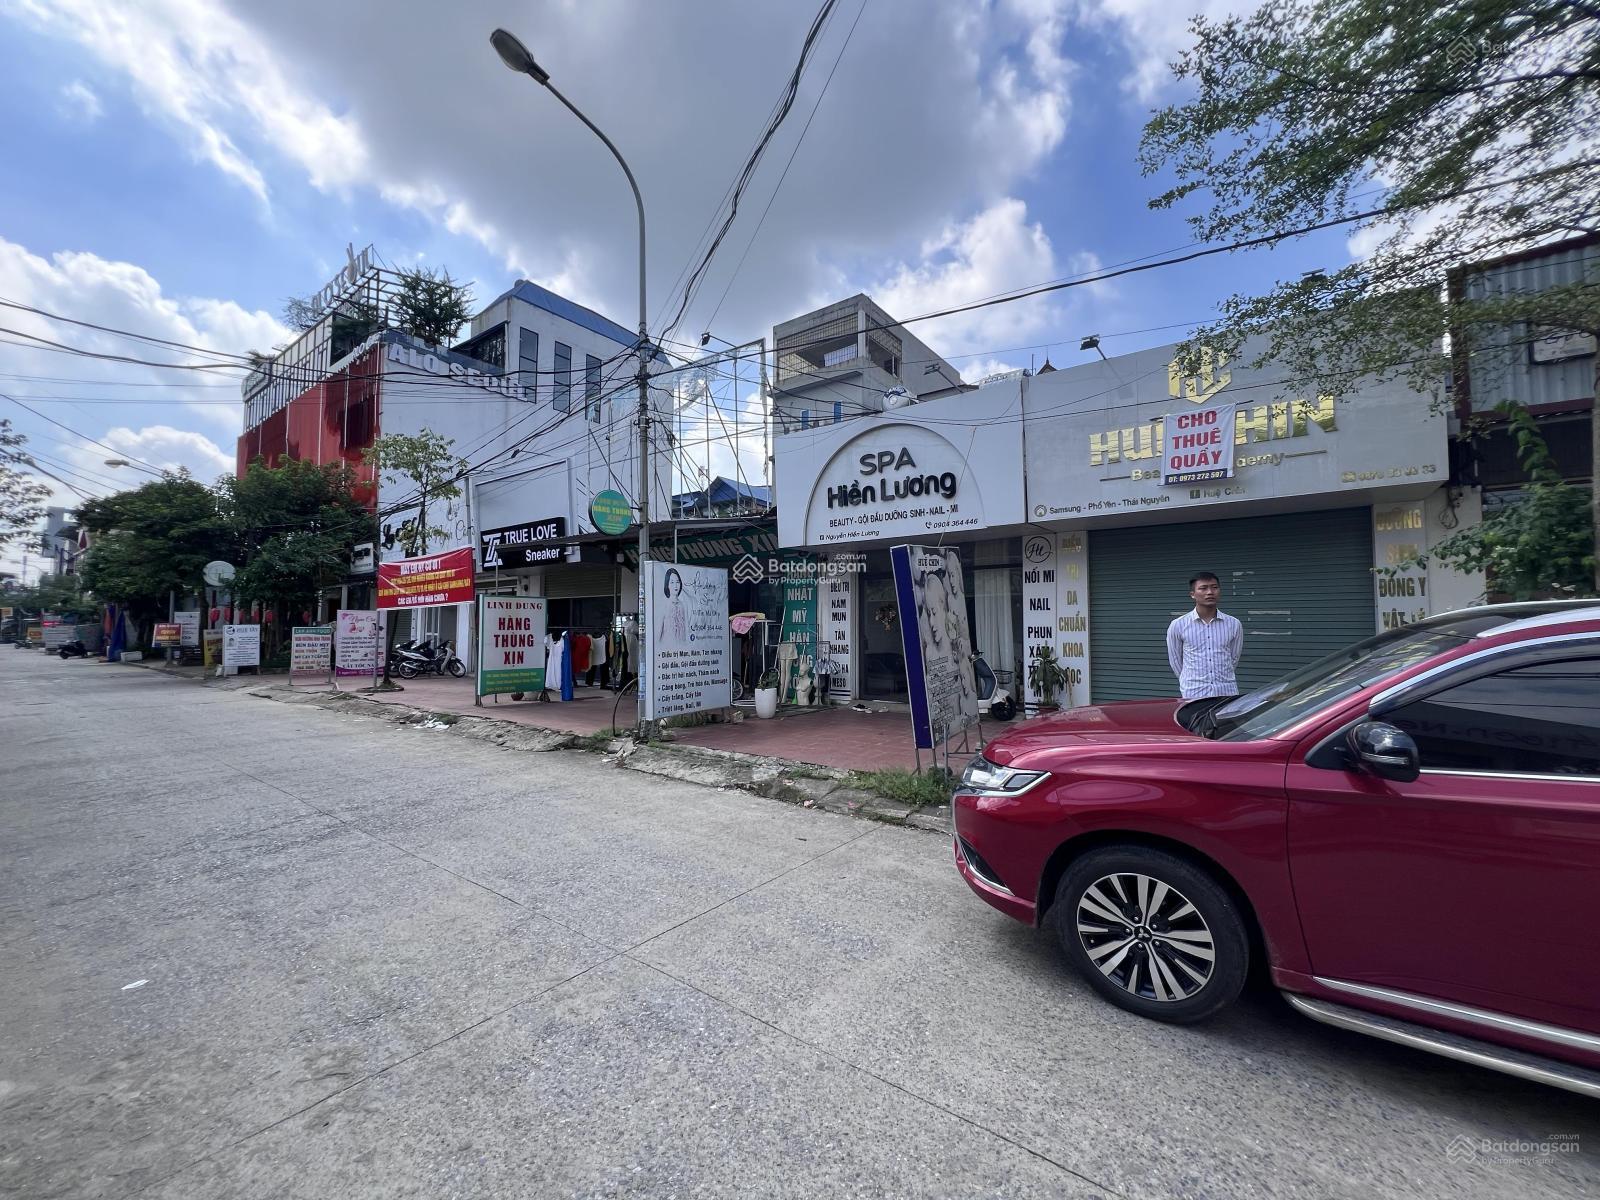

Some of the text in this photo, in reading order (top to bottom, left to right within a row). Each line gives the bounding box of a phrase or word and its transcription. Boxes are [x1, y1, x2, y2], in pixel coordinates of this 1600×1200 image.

[1177, 410, 1217, 429] CHO
[1235, 395, 1338, 446] HIN
[1172, 427, 1221, 450] THUÊ
[859, 447, 916, 475] SPA
[1130, 468, 1161, 481] Bea
[1179, 474, 1196, 483] 0973
[1197, 472, 1210, 481] 272
[827, 472, 957, 510] Hiền Lương
[1049, 505, 1082, 515] Samsung
[1088, 501, 1102, 511] Phố
[1140, 494, 1170, 506] Nguyên
[829, 516, 854, 528] BEAUTY
[857, 515, 870, 526] GỘI
[884, 509, 908, 521] DƯỠNG
[909, 508, 925, 518] SINH
[929, 506, 945, 517] NAIL
[503, 529, 529, 545] TRUE
[530, 524, 557, 541] LOVE
[525, 548, 560, 562] Sneaker
[625, 545, 675, 563] HNG
[677, 537, 744, 560] THÙNG
[1024, 566, 1055, 584] NỐI MI
[487, 601, 542, 610] LINH DUNG
[1029, 597, 1051, 611] NAIL
[1066, 590, 1078, 605] DA
[498, 614, 531, 631] HÀNG
[792, 607, 808, 623] MỸ
[831, 611, 847, 624] MỤN
[493, 631, 534, 648] THÙNG
[1027, 626, 1052, 639] PHUN
[1062, 642, 1084, 658] KHOA
[503, 651, 524, 667] XỊN
